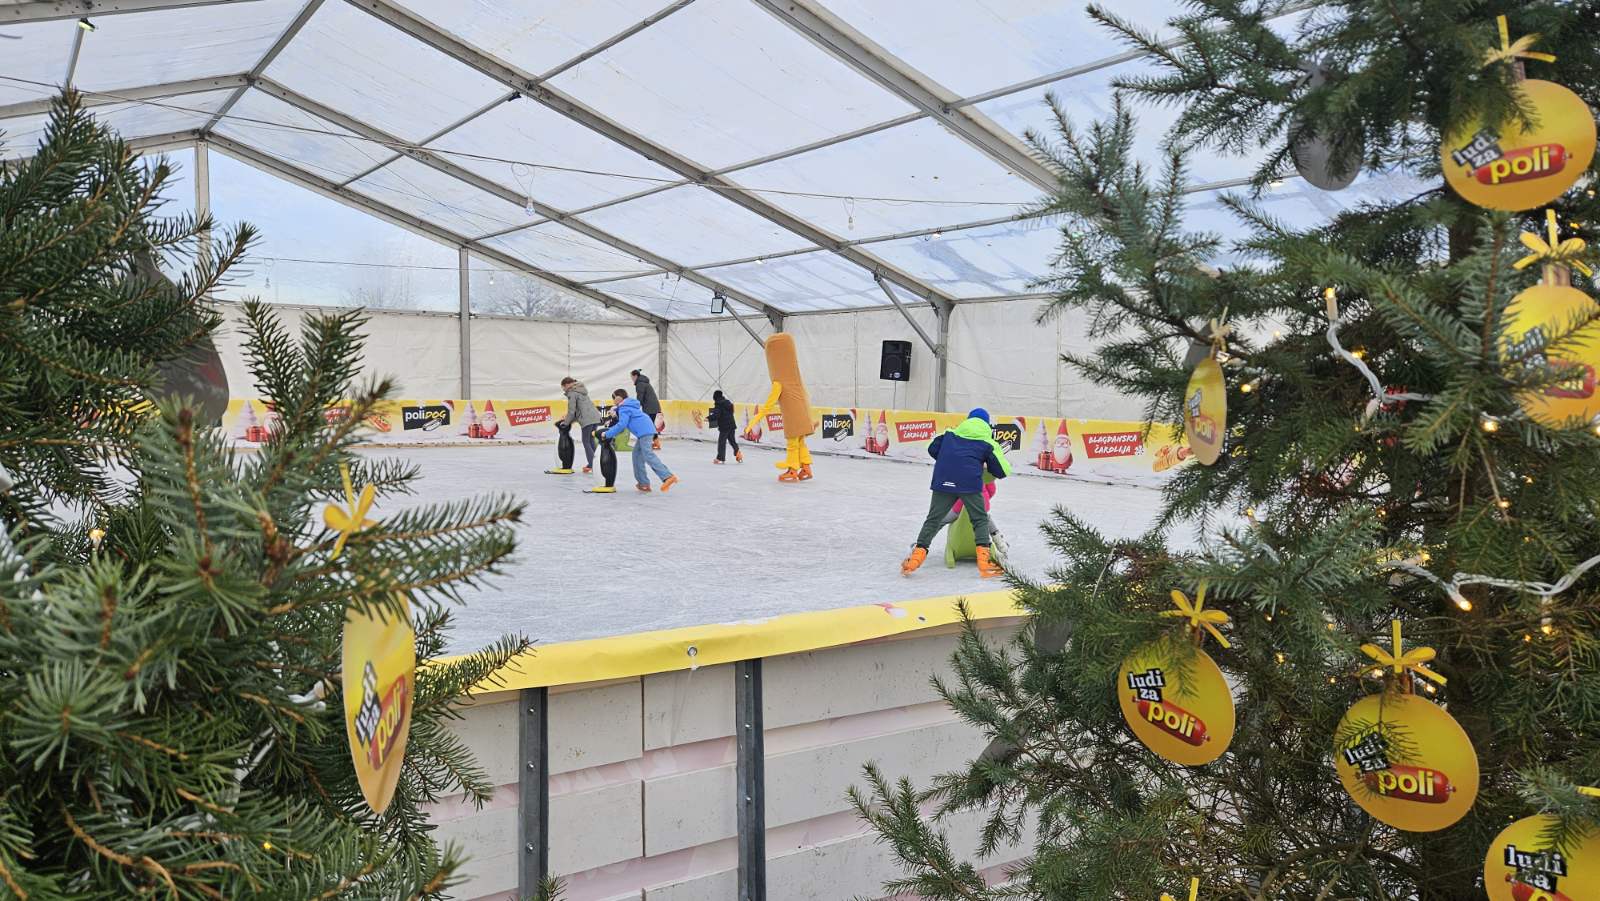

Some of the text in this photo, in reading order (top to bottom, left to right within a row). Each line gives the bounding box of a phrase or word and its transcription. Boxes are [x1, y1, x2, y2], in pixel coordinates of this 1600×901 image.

[1471, 148, 1499, 167] za
[1490, 146, 1550, 184] poli
[1088, 434, 1138, 445] BLAGDANSKA
[1094, 443, 1131, 455] ČAROLIJA
[1129, 669, 1163, 688] ludi
[1140, 688, 1160, 701] za
[378, 681, 401, 764] poli
[1147, 702, 1196, 738] poli
[1378, 770, 1434, 796] poli
